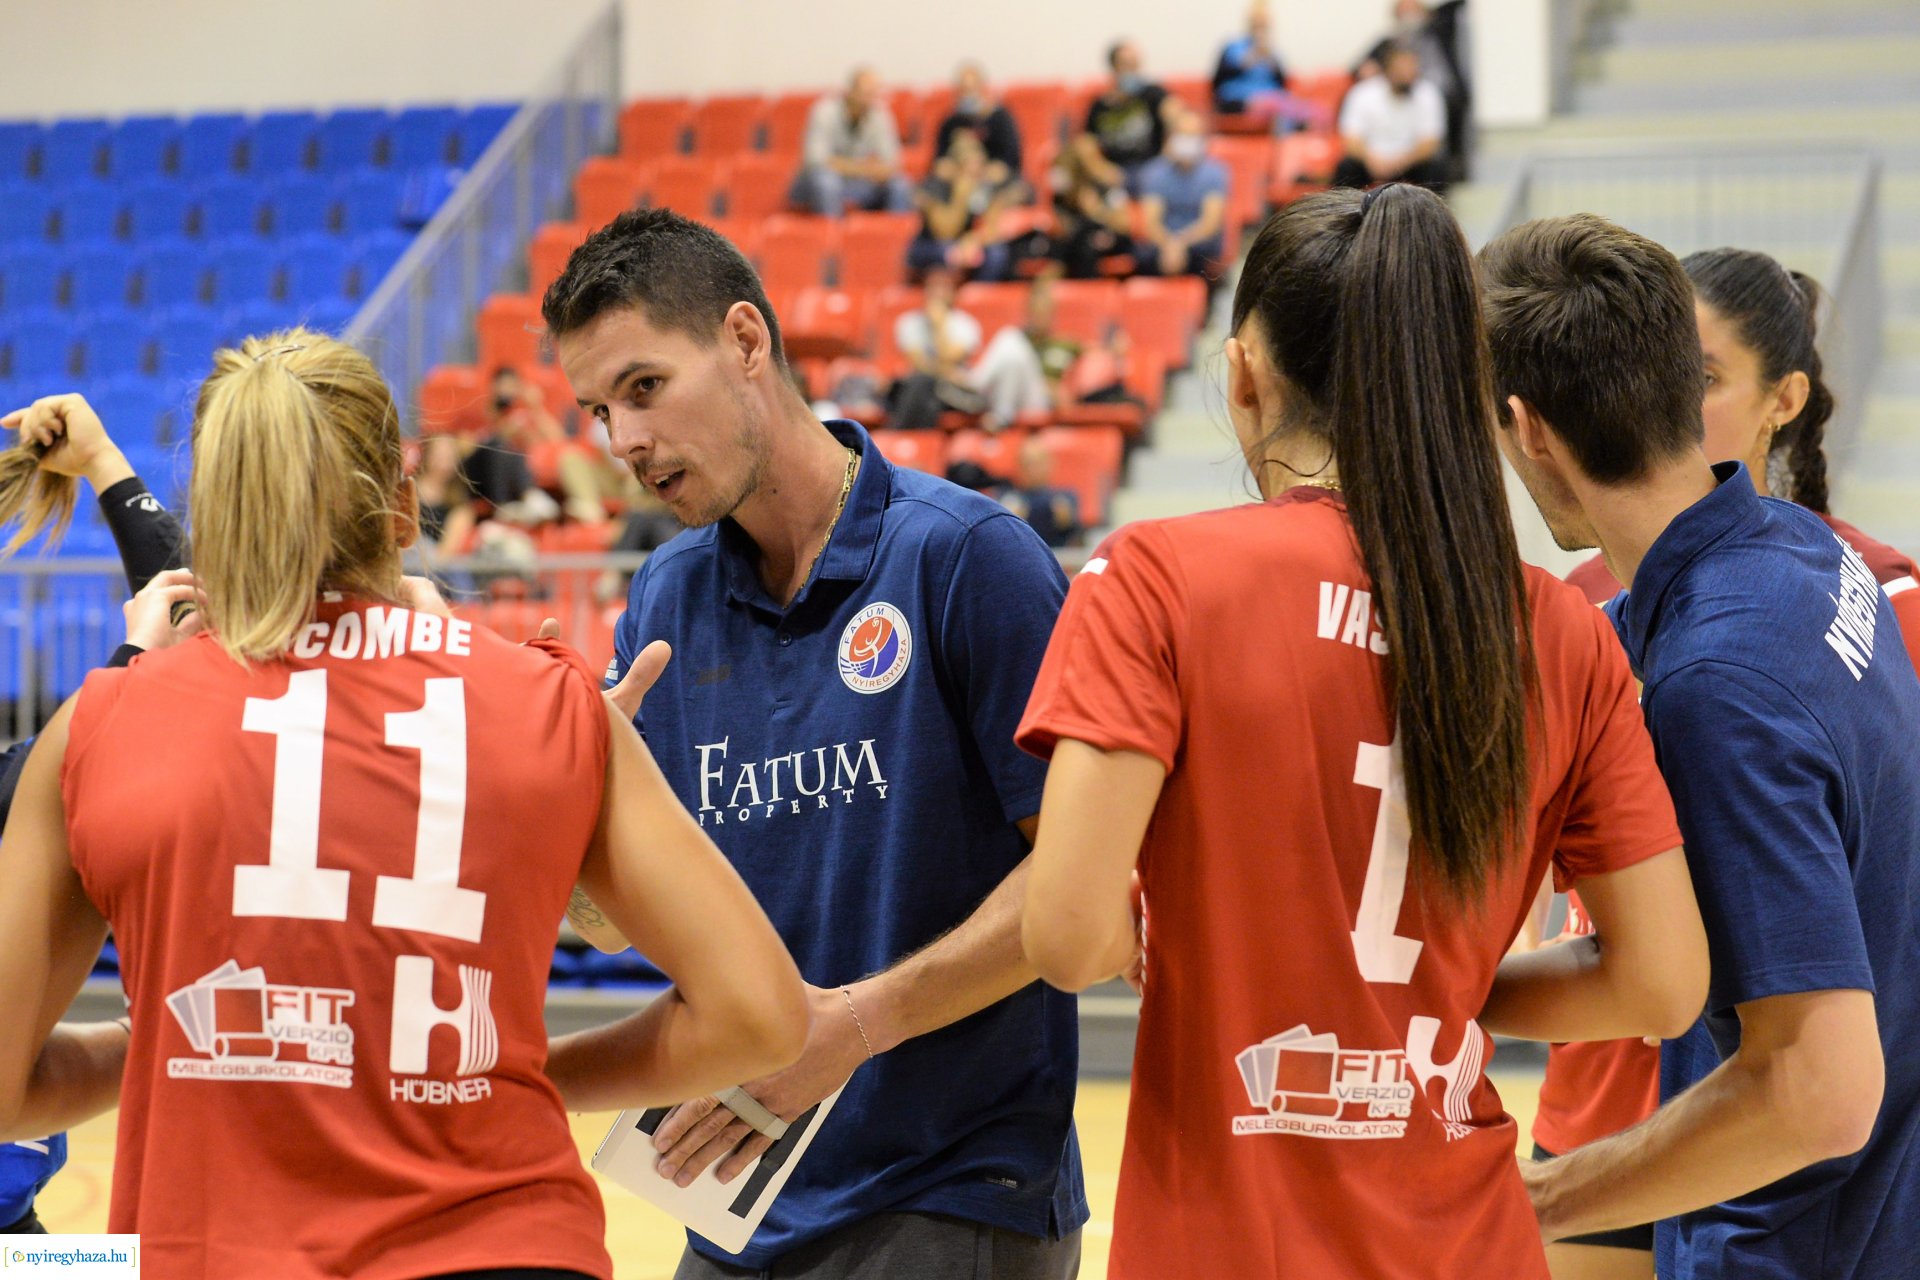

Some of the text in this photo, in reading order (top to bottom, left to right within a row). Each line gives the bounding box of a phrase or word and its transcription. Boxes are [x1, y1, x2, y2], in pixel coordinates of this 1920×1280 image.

[284, 606, 472, 661] COMBE
[844, 607, 884, 645] FATUM
[232, 668, 486, 943] 11
[698, 785, 888, 826] PROPERTY
[266, 989, 350, 1026] FIT
[1336, 1053, 1407, 1083] FIT
[390, 1077, 492, 1105] HÜBNER
[1235, 1117, 1403, 1136] MELEGBURKOLATOK
